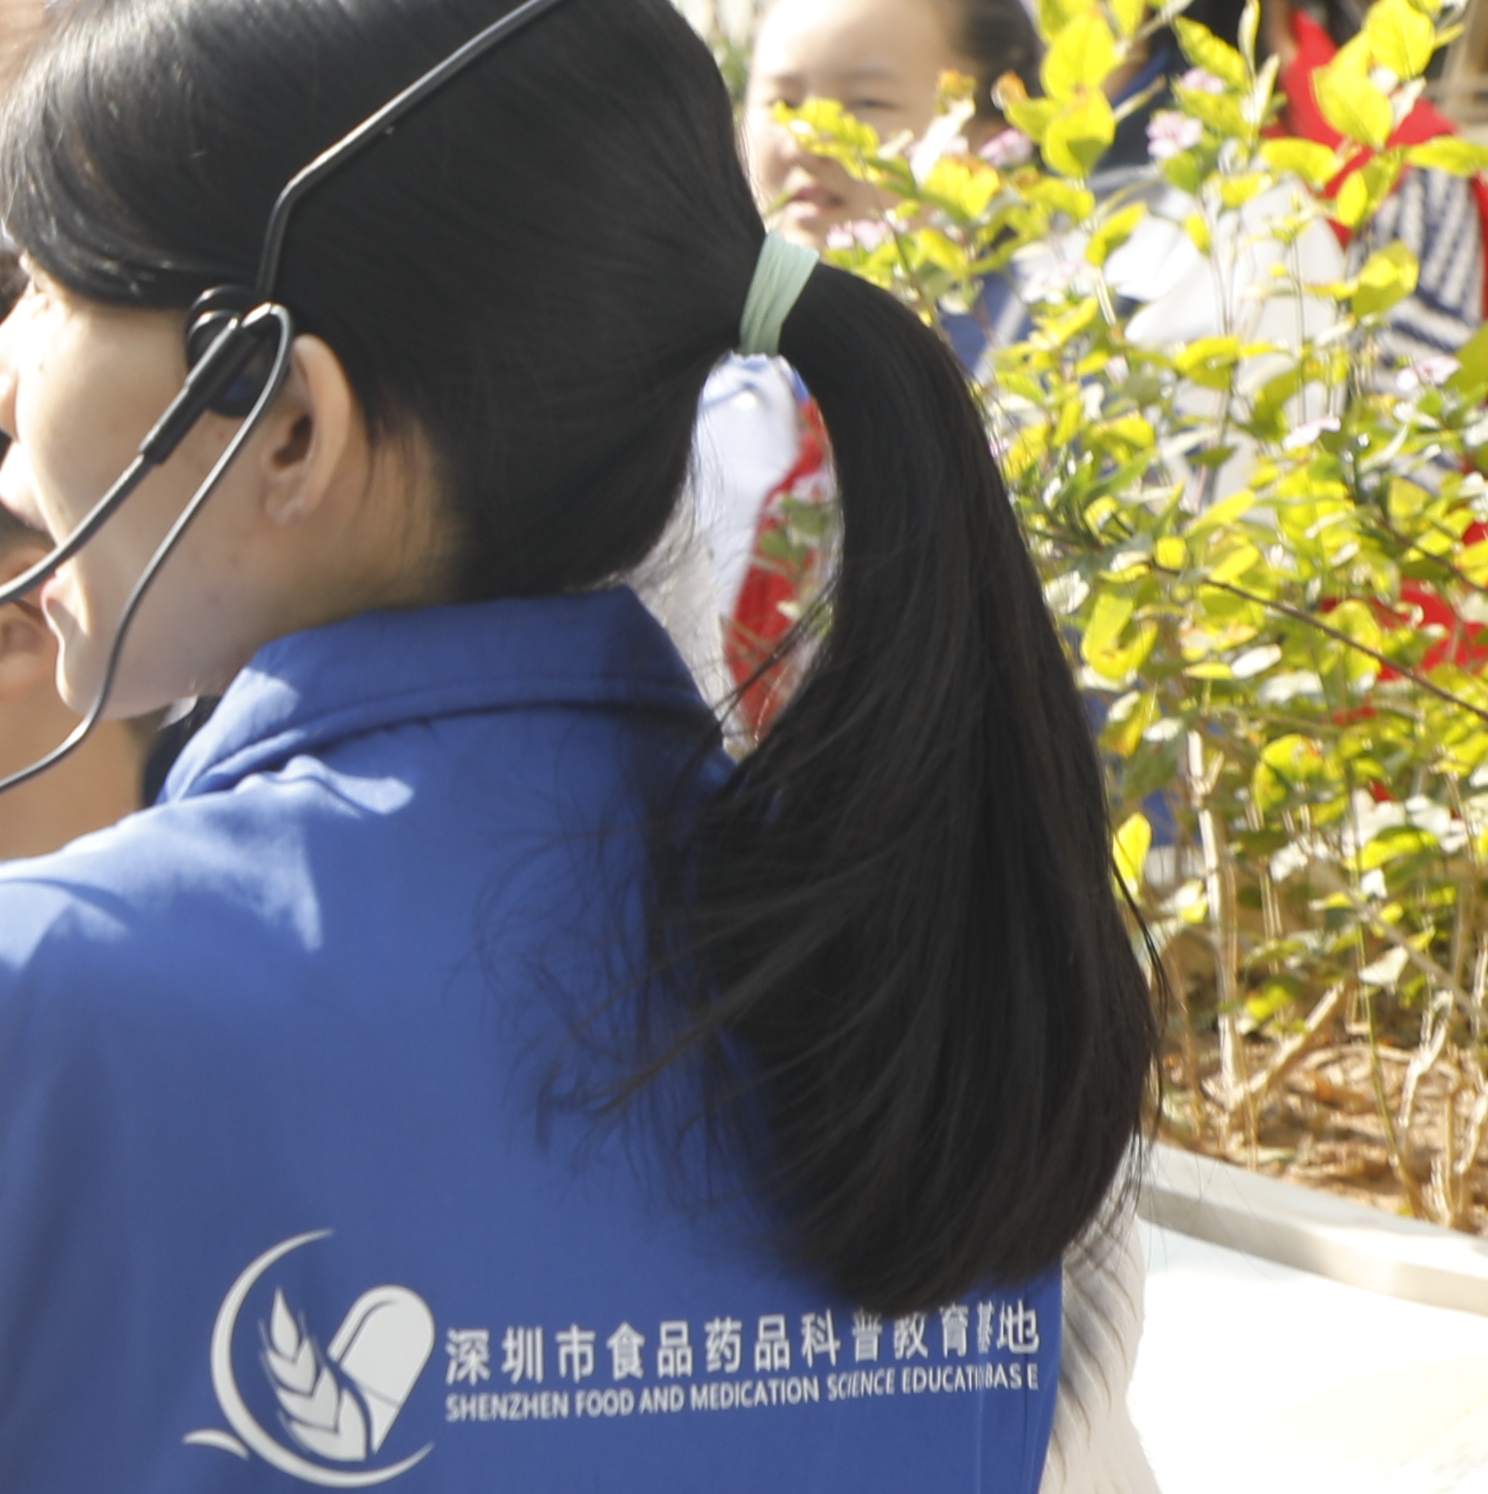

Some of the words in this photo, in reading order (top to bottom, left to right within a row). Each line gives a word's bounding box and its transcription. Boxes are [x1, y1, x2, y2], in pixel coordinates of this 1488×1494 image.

[445, 1391, 570, 1423] SHENZHEN
[574, 1388, 635, 1419] FOOD
[640, 1384, 685, 1415] AND
[690, 1374, 820, 1412] MEDICATION
[826, 1367, 896, 1402] SCIENCE
[901, 1363, 985, 1395] EDUCATI
